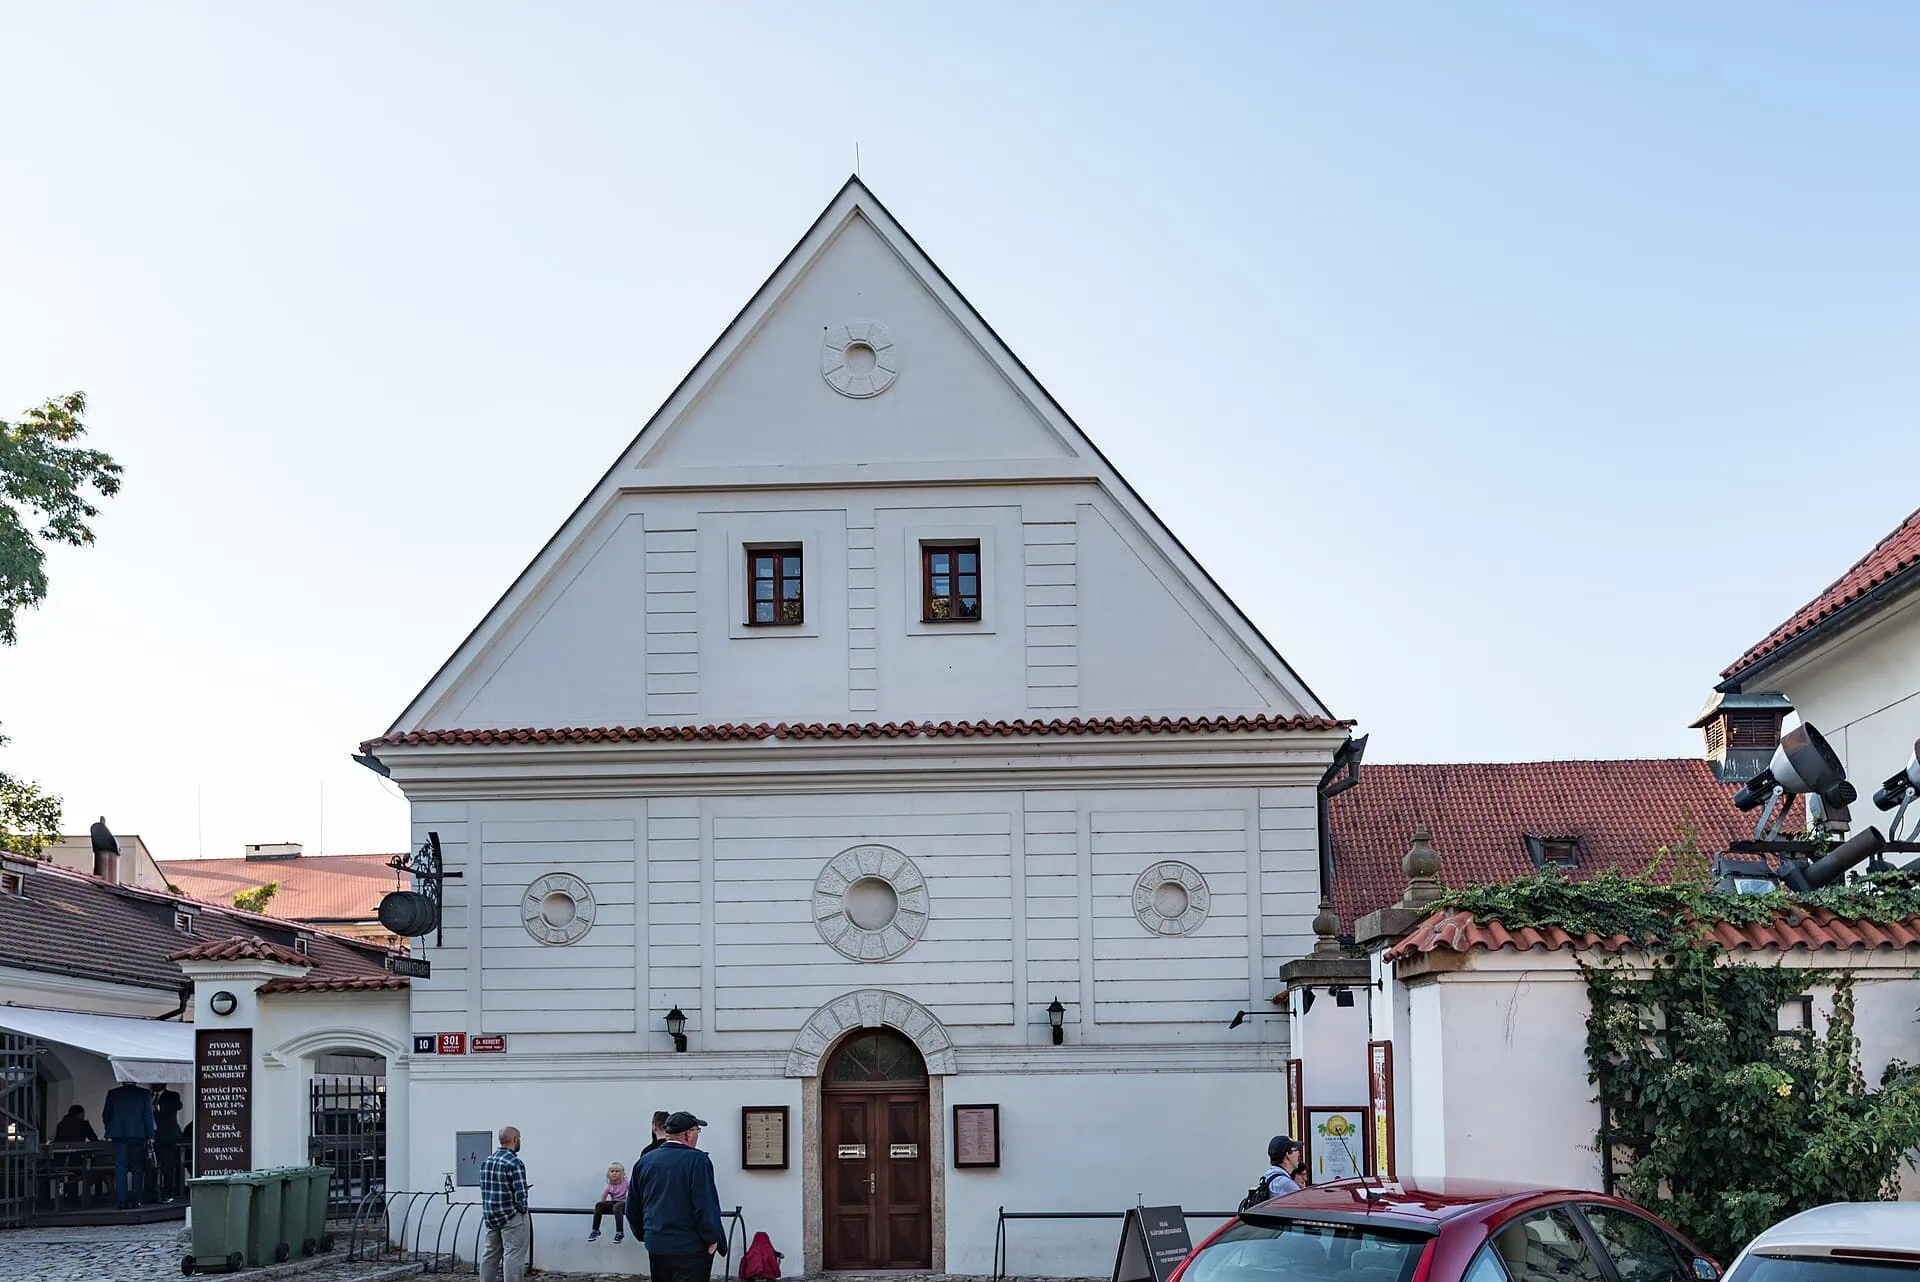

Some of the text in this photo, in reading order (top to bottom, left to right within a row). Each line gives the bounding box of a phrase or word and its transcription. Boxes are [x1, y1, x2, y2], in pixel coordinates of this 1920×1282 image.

[419, 1039, 429, 1050] 10
[443, 1035, 459, 1045] 301
[207, 1049, 241, 1057] STRAHOV
[201, 1064, 248, 1072] RESTAURACE
[201, 1085, 230, 1094] DOMÁCÍ
[202, 1094, 231, 1102] JANTAR
[204, 1101, 229, 1109] TMAVÉ
[210, 1109, 223, 1117] IPA
[211, 1122, 236, 1131] ČESKÁ
[206, 1130, 242, 1139] KUCHYNĚ
[203, 1145, 244, 1154] MORAVSKÁ
